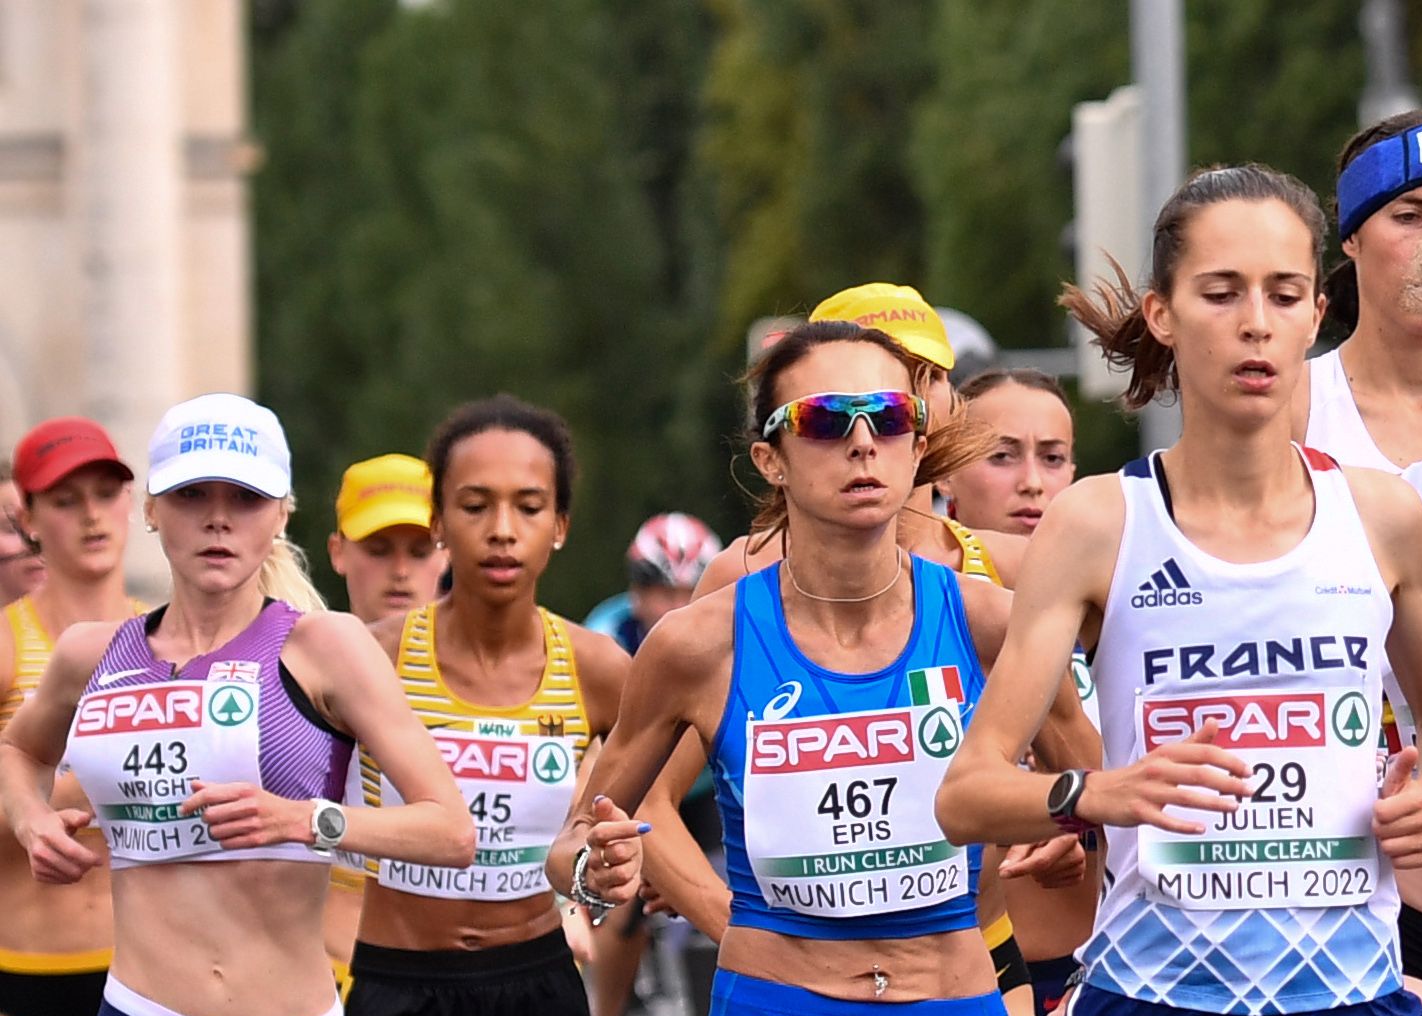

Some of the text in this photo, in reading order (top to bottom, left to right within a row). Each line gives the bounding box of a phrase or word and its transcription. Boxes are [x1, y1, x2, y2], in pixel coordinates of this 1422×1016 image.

[855, 308, 926, 326] RMANY
[179, 438, 258, 456] BRITAIN
[180, 424, 258, 440] GREAT
[1131, 589, 1203, 608] adidas
[1143, 635, 1368, 685] FRANCE
[78, 690, 200, 732] SPAR
[1148, 701, 1321, 745] SPAR
[122, 741, 188, 777] 443
[436, 742, 525, 777] PAR
[754, 719, 910, 767] SPAR
[817, 777, 898, 821] 467
[1228, 762, 1307, 804] 29
[468, 791, 512, 824] 45
[1214, 807, 1313, 831] JULIEN
[111, 826, 181, 852] MUNICH
[832, 821, 891, 845] EPIS
[802, 861, 808, 875] I
[814, 853, 856, 874] RUN
[1200, 843, 1205, 861] I
[1212, 843, 1258, 861] RUN
[389, 861, 543, 893] MUNICH 2022
[771, 864, 961, 908] MUNICH 2022
[1158, 867, 1372, 900] MUNICH 2022
